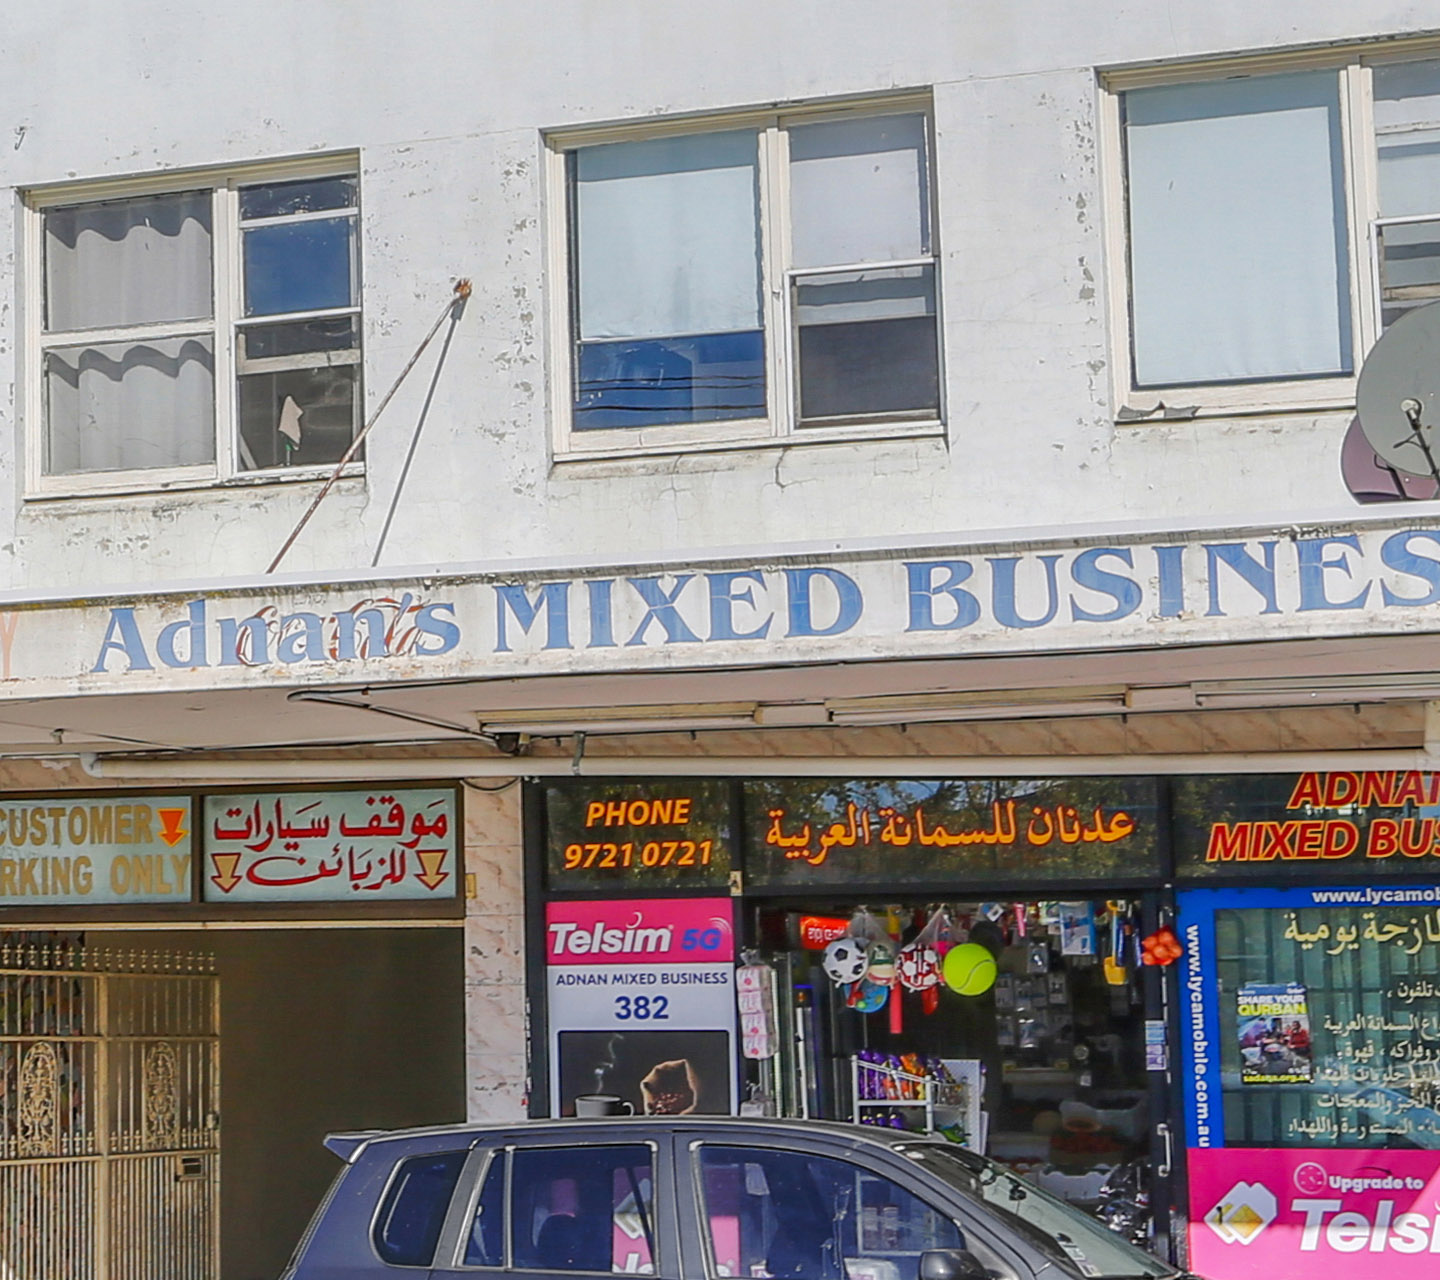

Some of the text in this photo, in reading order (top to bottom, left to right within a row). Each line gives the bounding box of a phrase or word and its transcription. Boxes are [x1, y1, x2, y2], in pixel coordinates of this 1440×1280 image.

[91, 589, 462, 673] Adnan's
[492, 566, 863, 654] MIXED
[585, 798, 691, 827] PHONE
[766, 799, 1134, 865] عدنان للسمانة العربية
[1206, 822, 1359, 862] MIXED
[565, 840, 712, 869] 9721 0721
[110, 854, 191, 896] ONLY
[549, 912, 722, 954] Telsim 5G
[1283, 912, 1357, 956] يومية
[556, 972, 728, 986] ADNAN MIXED BUSINESS
[614, 995, 669, 1020] 382
[1238, 1003, 1307, 1016] QURBAN
[1276, 995, 1305, 1003] YOUR
[1186, 924, 1211, 1148] www.lycamobile.com.au
[1328, 1175, 1424, 1192] Upgrade to
